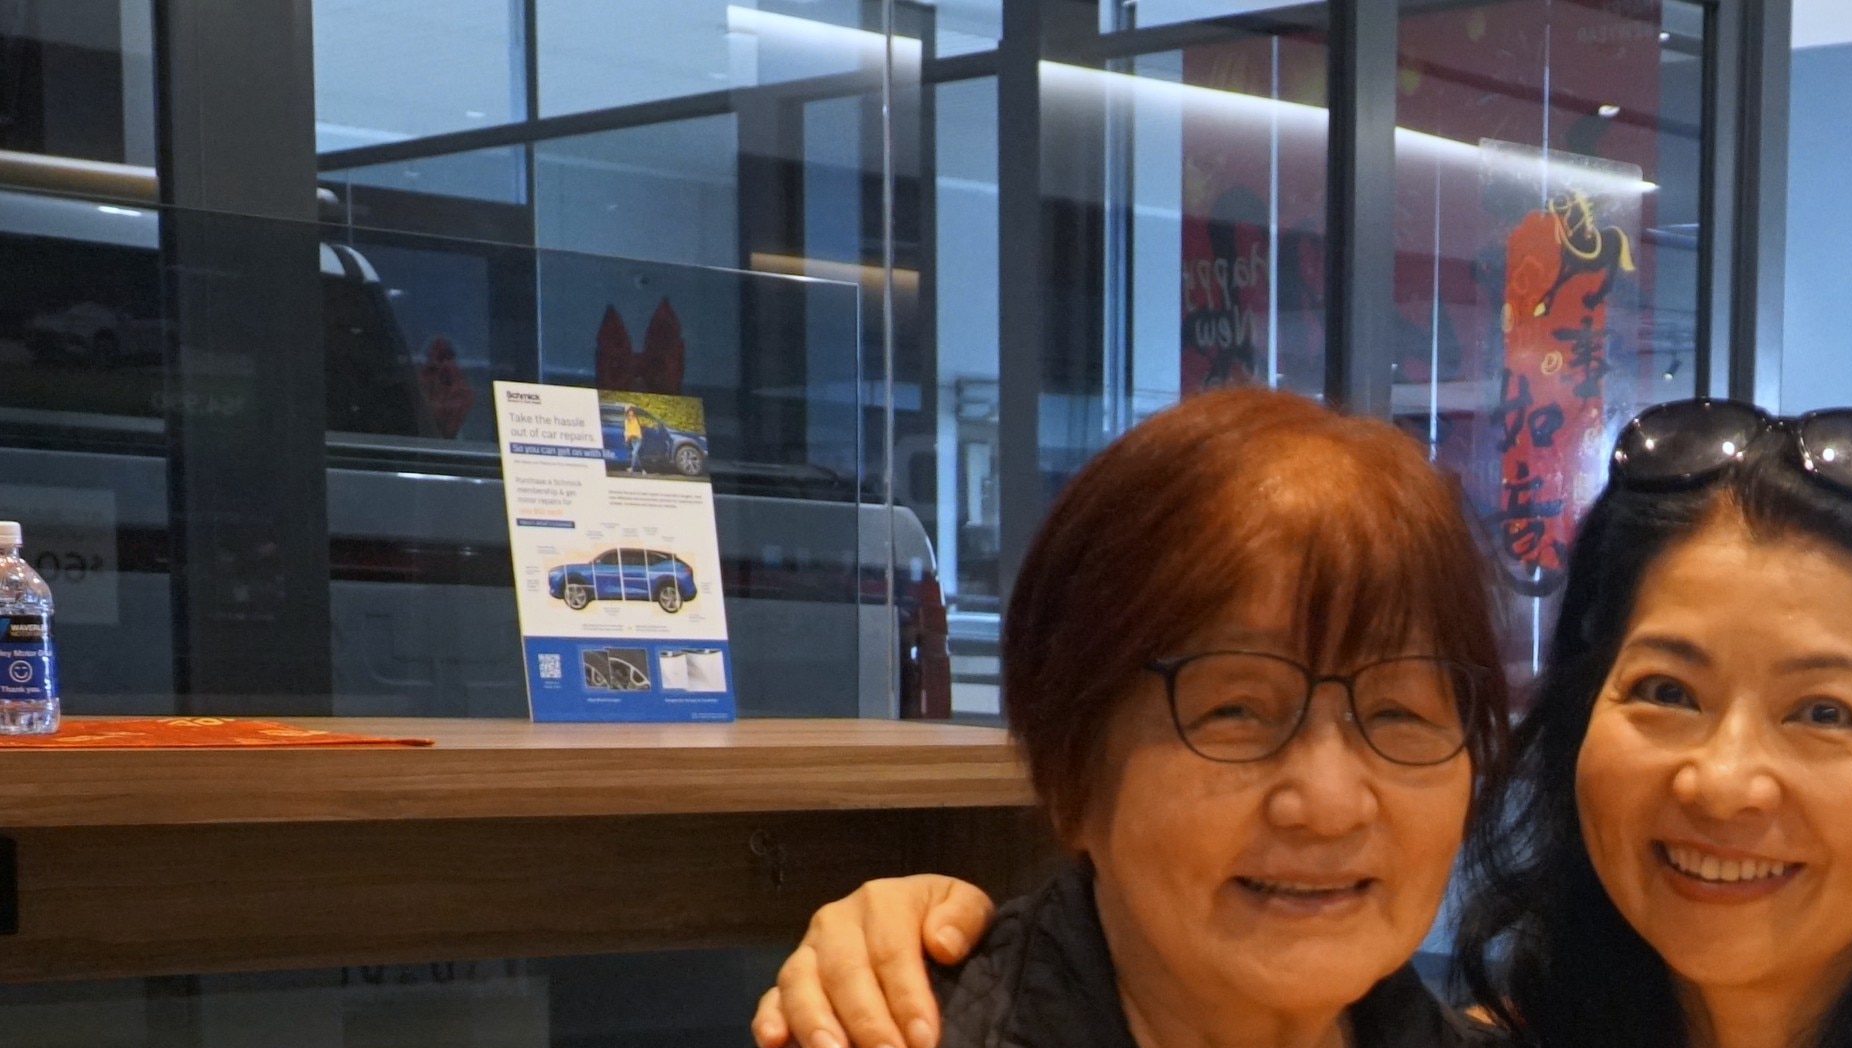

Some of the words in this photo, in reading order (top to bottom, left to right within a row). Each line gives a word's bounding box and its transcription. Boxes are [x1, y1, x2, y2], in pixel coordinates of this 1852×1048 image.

[509, 413, 533, 424] Take
[534, 415, 552, 425] the
[554, 416, 585, 427] hassle
[510, 428, 527, 438] out
[529, 429, 539, 438] of
[541, 432, 557, 440] car
[525, 446, 540, 455] you
